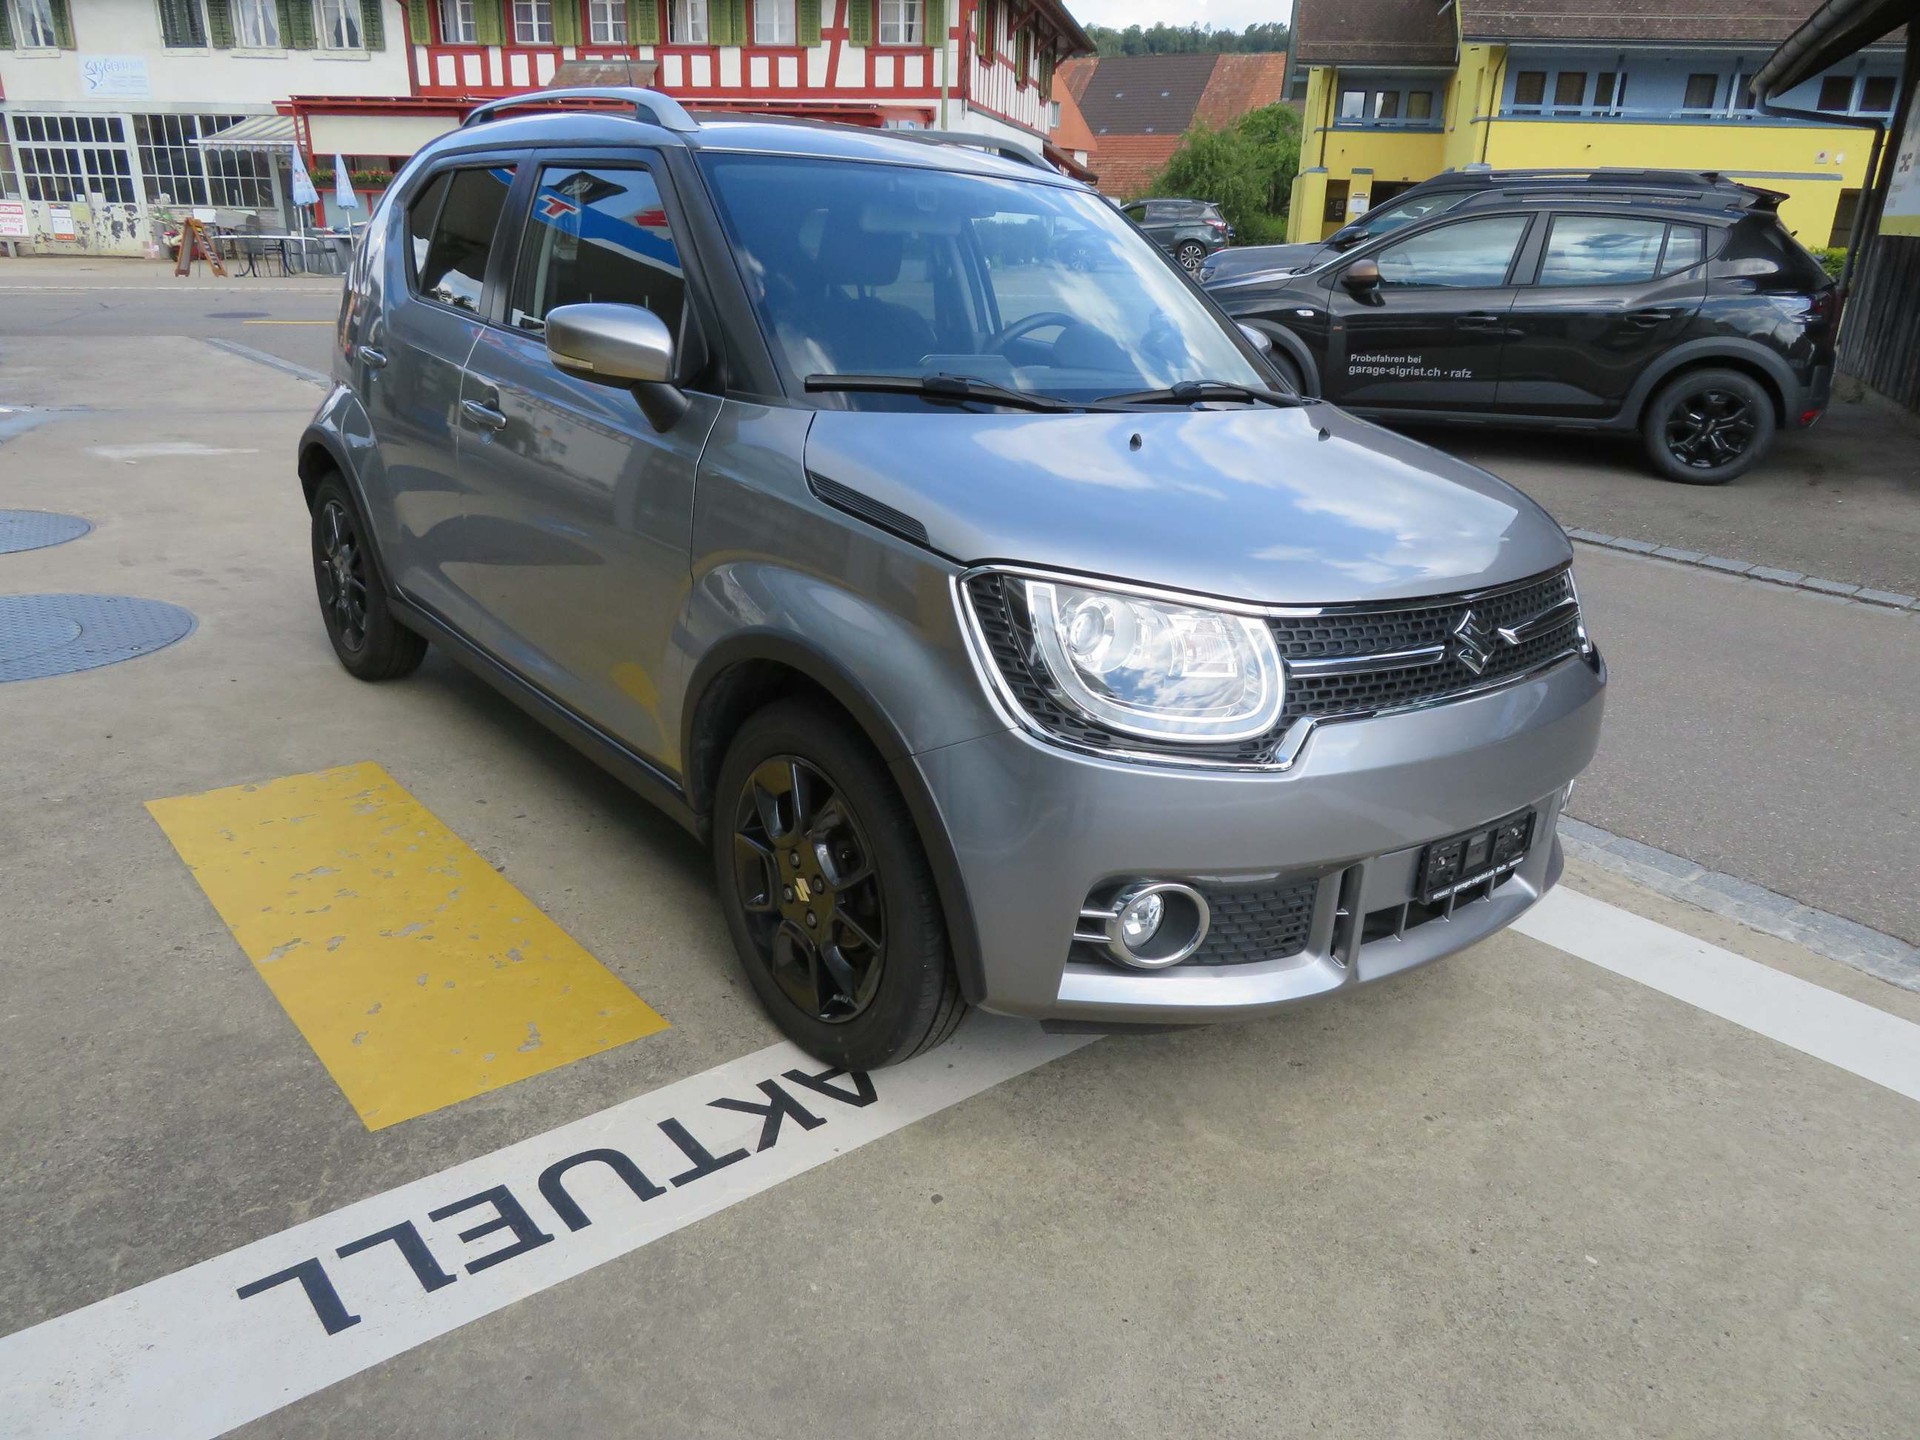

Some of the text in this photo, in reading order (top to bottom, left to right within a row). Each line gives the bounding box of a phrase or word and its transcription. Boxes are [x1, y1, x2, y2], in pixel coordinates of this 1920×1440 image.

[1350, 354, 1422, 364] Probefahren bei
[1348, 365, 1472, 378] garage-sigrist.ch rafz
[237, 1067, 878, 1335] AKTUELL
